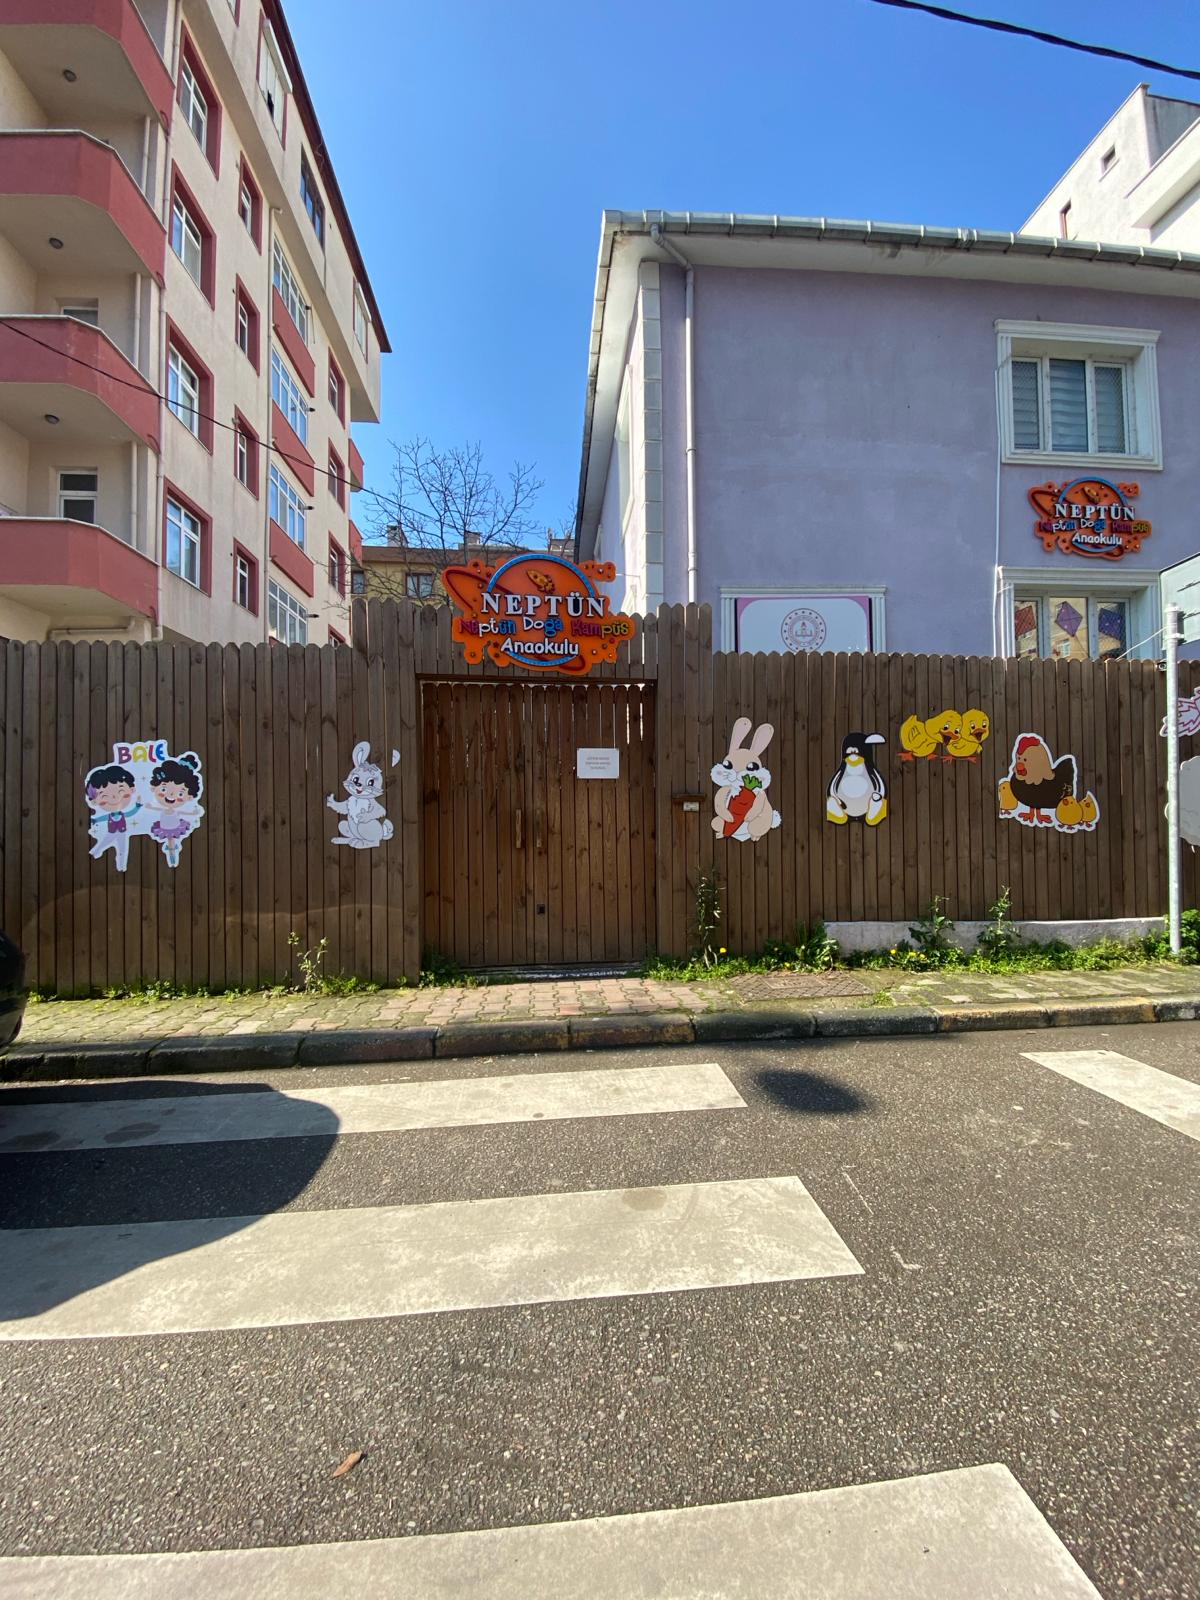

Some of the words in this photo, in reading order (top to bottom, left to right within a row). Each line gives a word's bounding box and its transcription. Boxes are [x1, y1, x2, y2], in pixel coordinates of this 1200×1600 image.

[1055, 503, 1135, 520] NEPTÜN
[1072, 532, 1123, 545] Anaokulu
[481, 592, 605, 617] NEPTÜN
[459, 617, 516, 638] Neptün
[571, 620, 630, 639] Kampüs
[501, 637, 578, 655] Anaokulu
[118, 743, 165, 764] BALE
